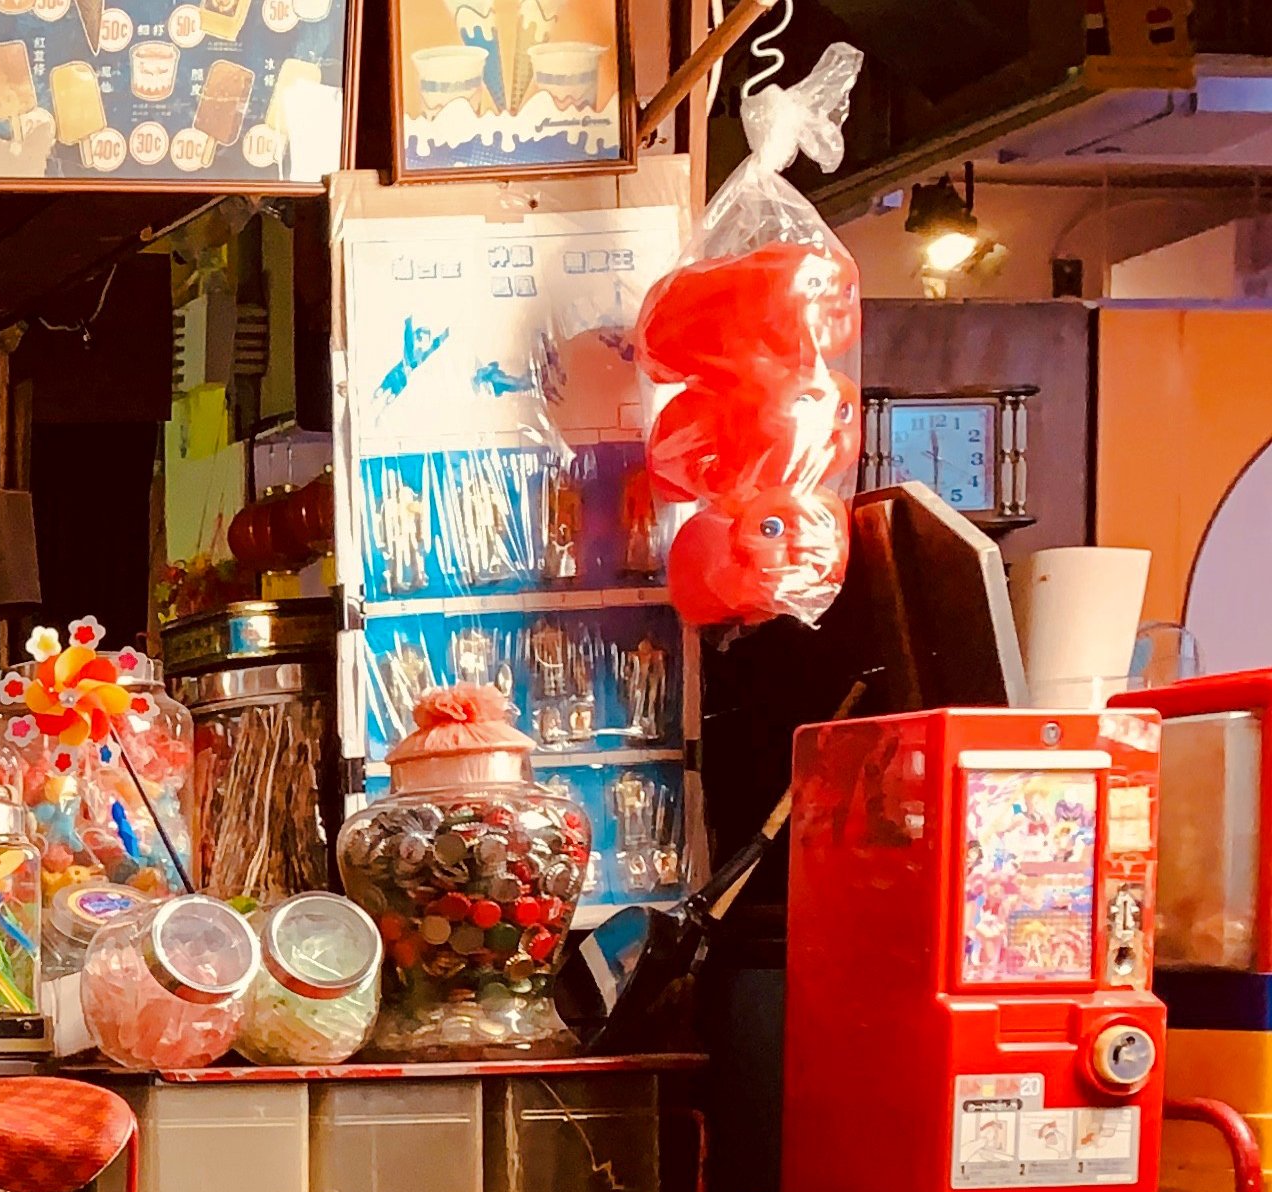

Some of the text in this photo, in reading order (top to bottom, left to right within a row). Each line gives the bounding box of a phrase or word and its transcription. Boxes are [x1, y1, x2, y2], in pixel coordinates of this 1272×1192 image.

[968, 430, 981, 443] 2
[971, 452, 984, 466] 3
[951, 489, 964, 503] 5
